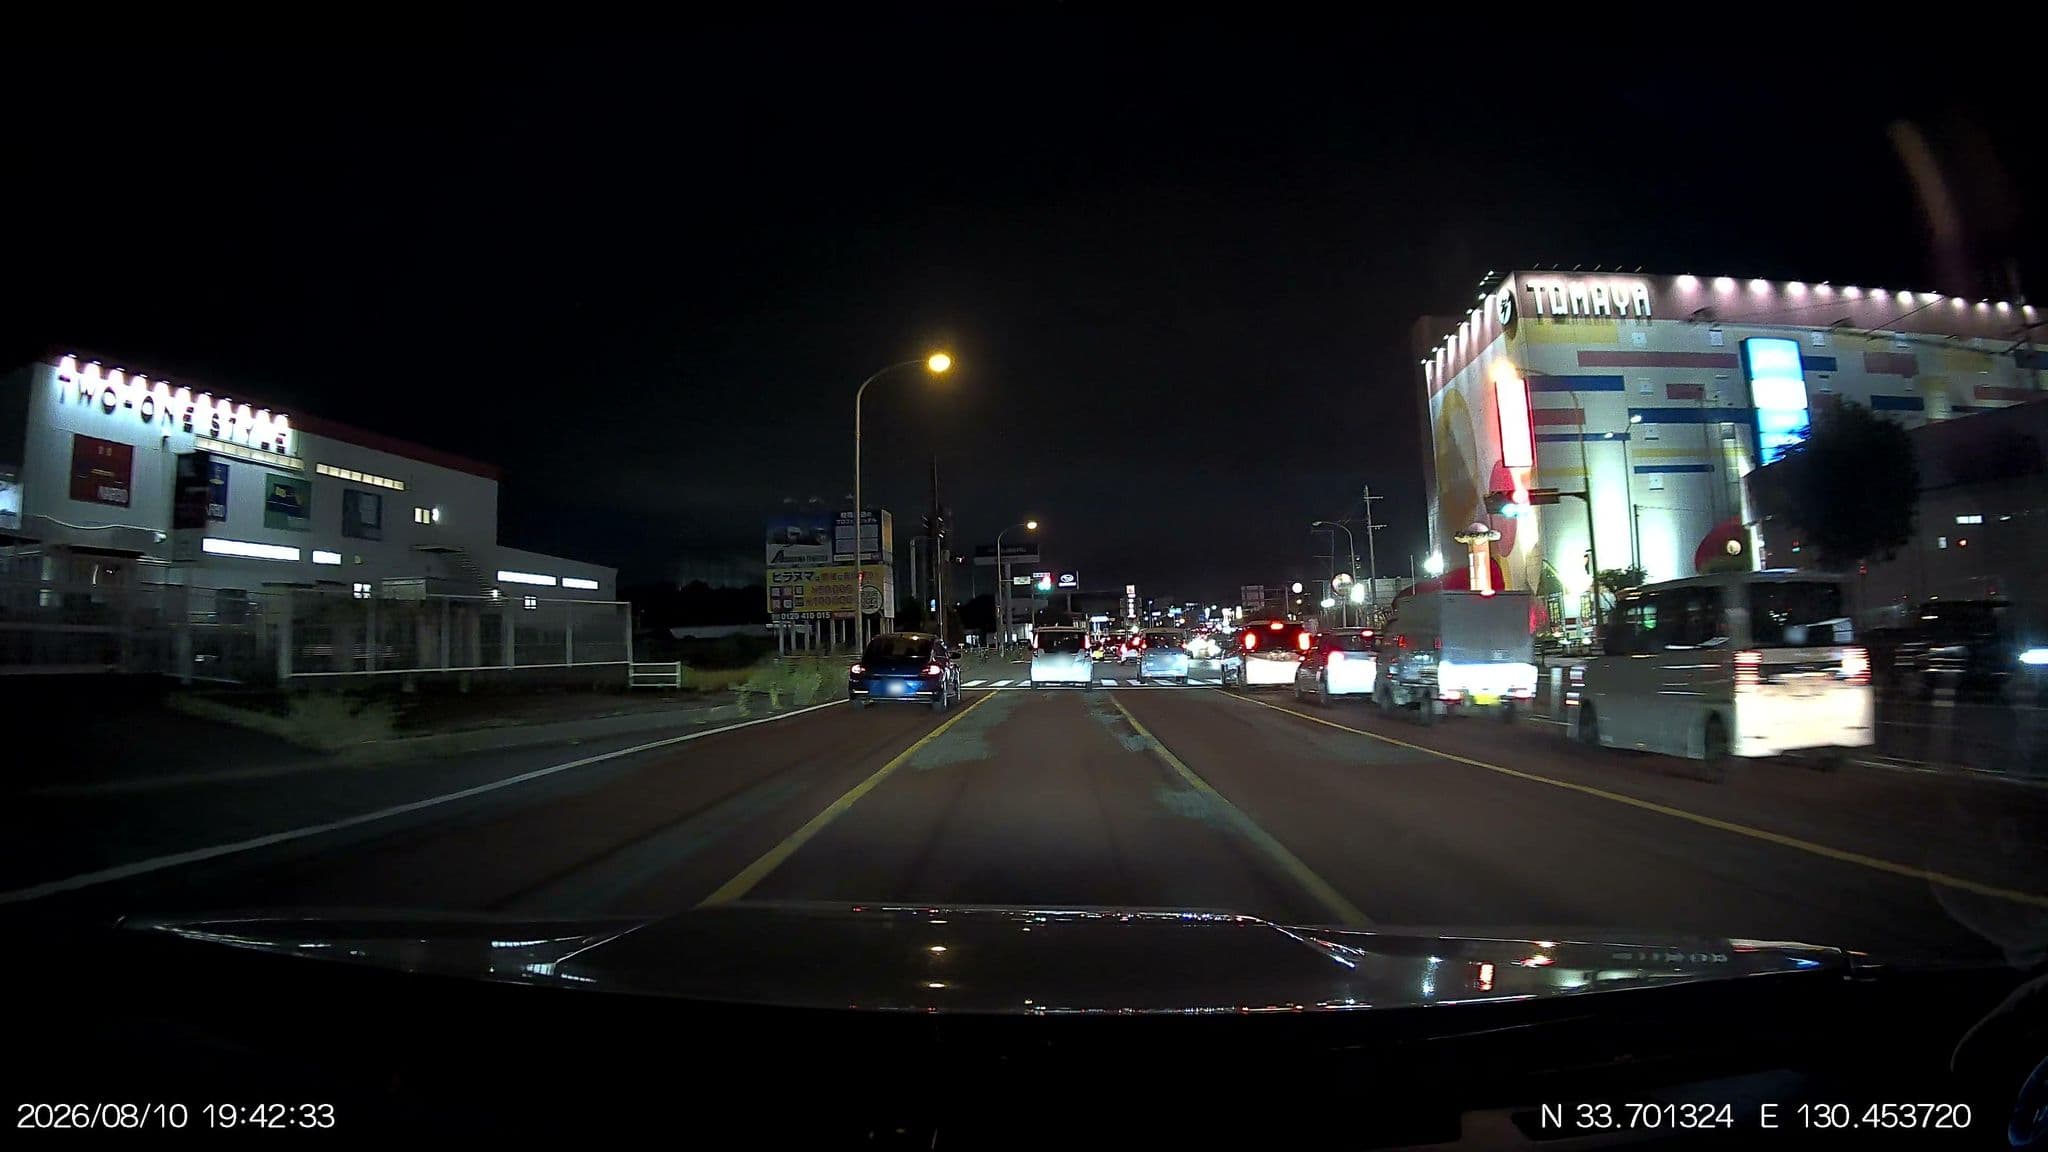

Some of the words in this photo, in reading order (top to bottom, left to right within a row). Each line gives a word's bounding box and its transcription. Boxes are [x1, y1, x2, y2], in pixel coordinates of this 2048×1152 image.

[1526, 279, 1651, 316] TOMAYA
[58, 373, 194, 434] TWO-ONE
[773, 571, 814, 582] ヒラヌマ
